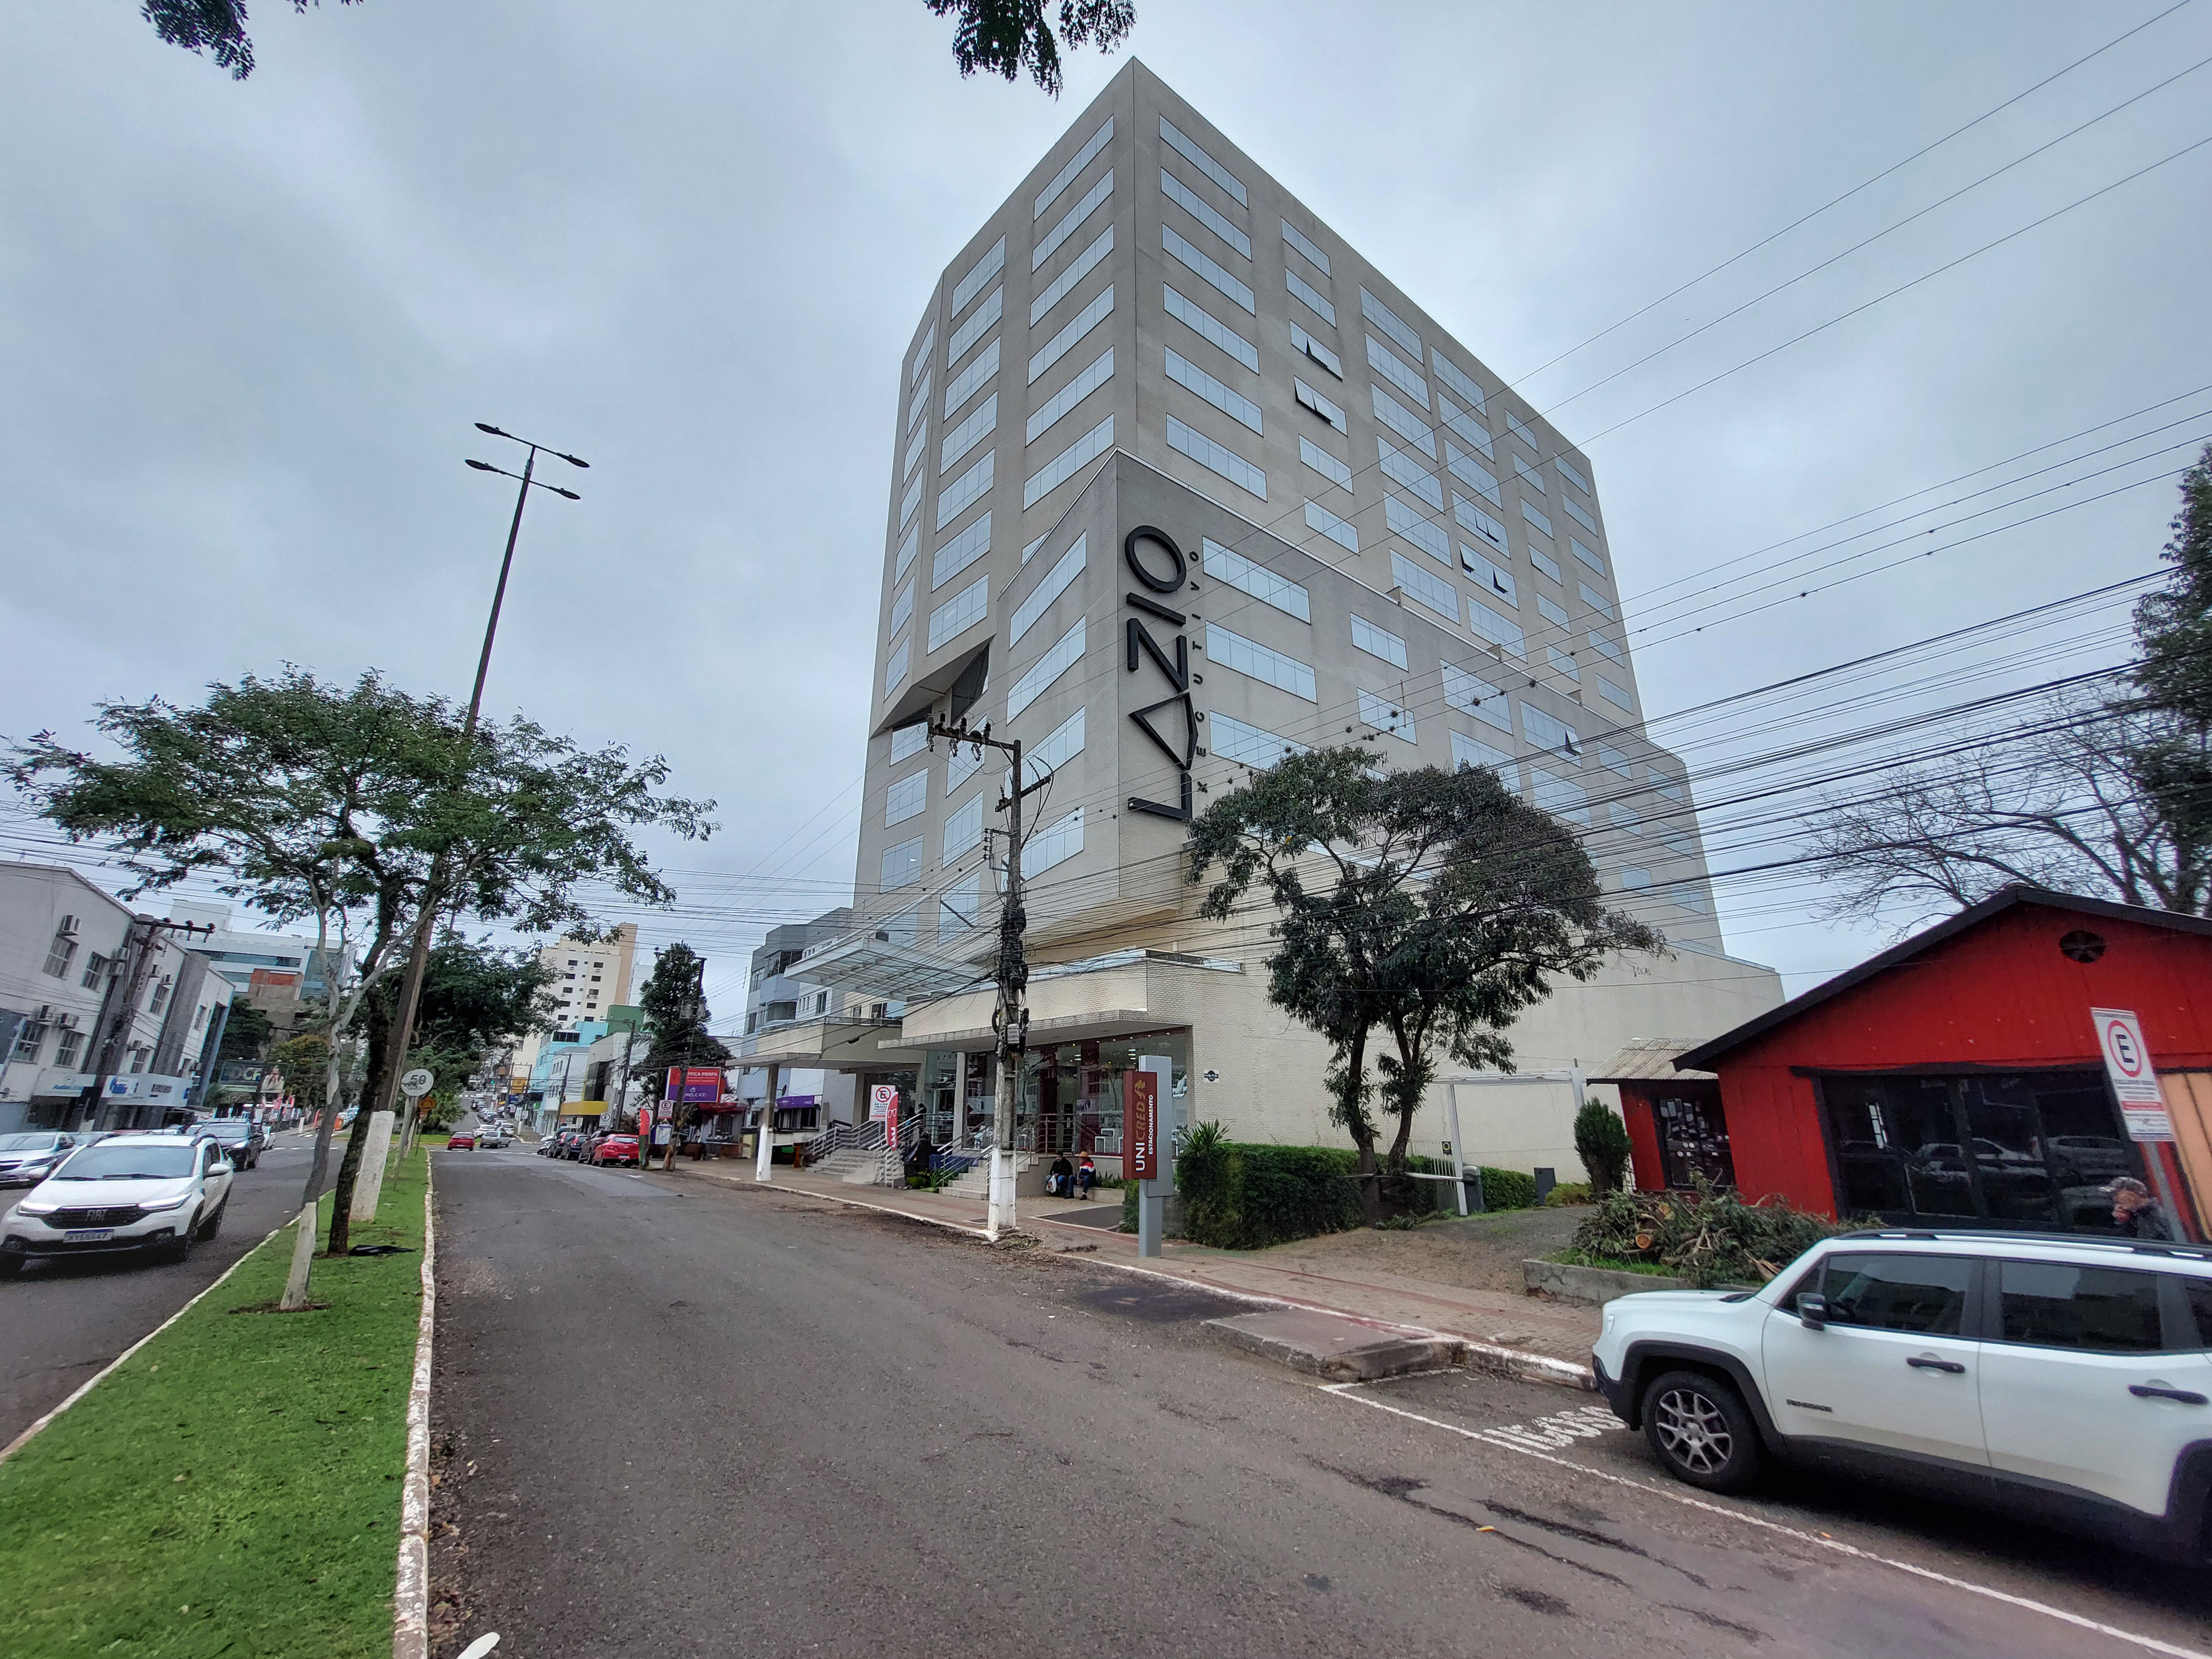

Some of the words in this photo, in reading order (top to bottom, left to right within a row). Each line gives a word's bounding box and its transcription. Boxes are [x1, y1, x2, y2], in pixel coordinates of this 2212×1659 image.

[1125, 525, 1198, 822] LAZIO
[1189, 551, 1208, 794] XECUTIVO
[411, 1075, 426, 1084] 50
[2116, 1034, 2135, 1063] E
[1135, 1101, 1145, 1171] UNICRED
